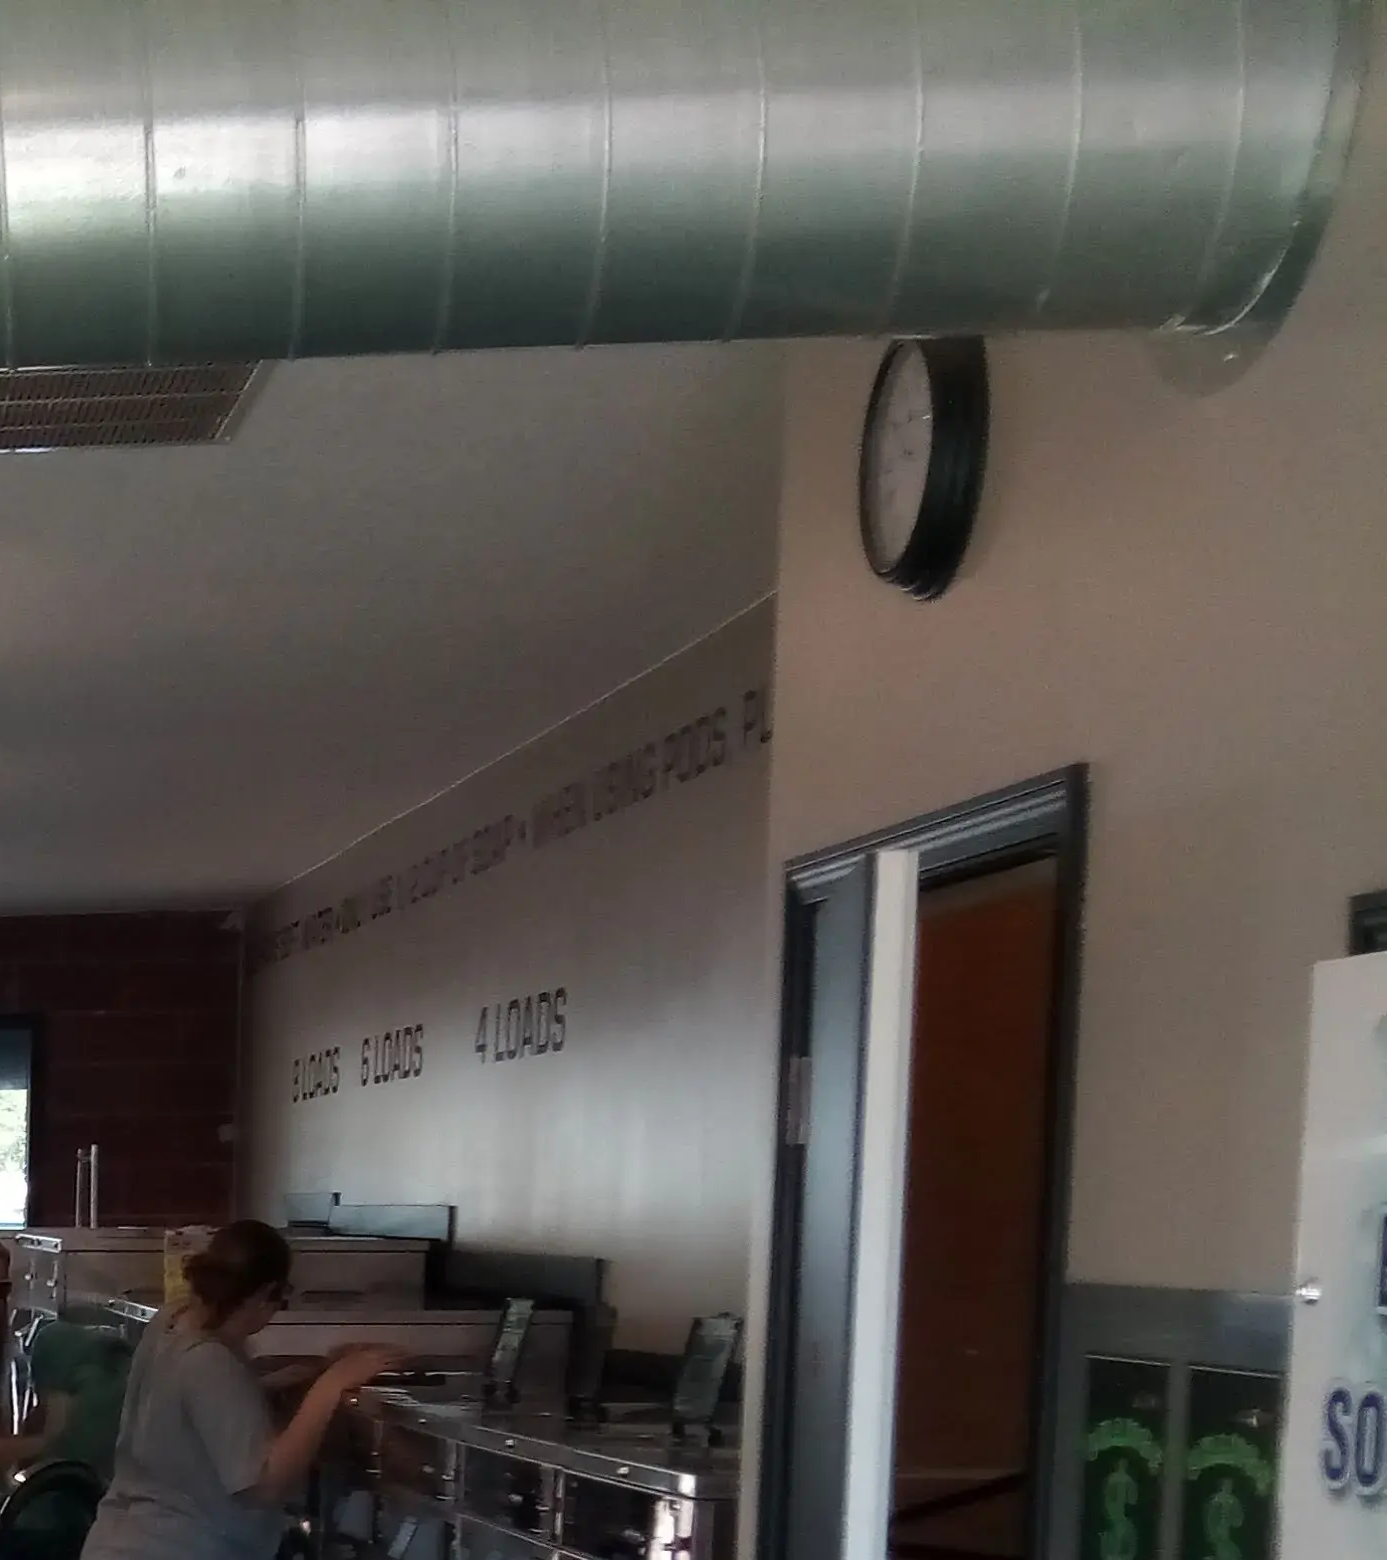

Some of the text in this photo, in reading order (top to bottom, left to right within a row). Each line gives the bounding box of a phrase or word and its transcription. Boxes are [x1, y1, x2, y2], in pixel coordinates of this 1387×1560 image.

[361, 1023, 425, 1087] 6 LOADS
[474, 986, 569, 1065] 4 LOADS
